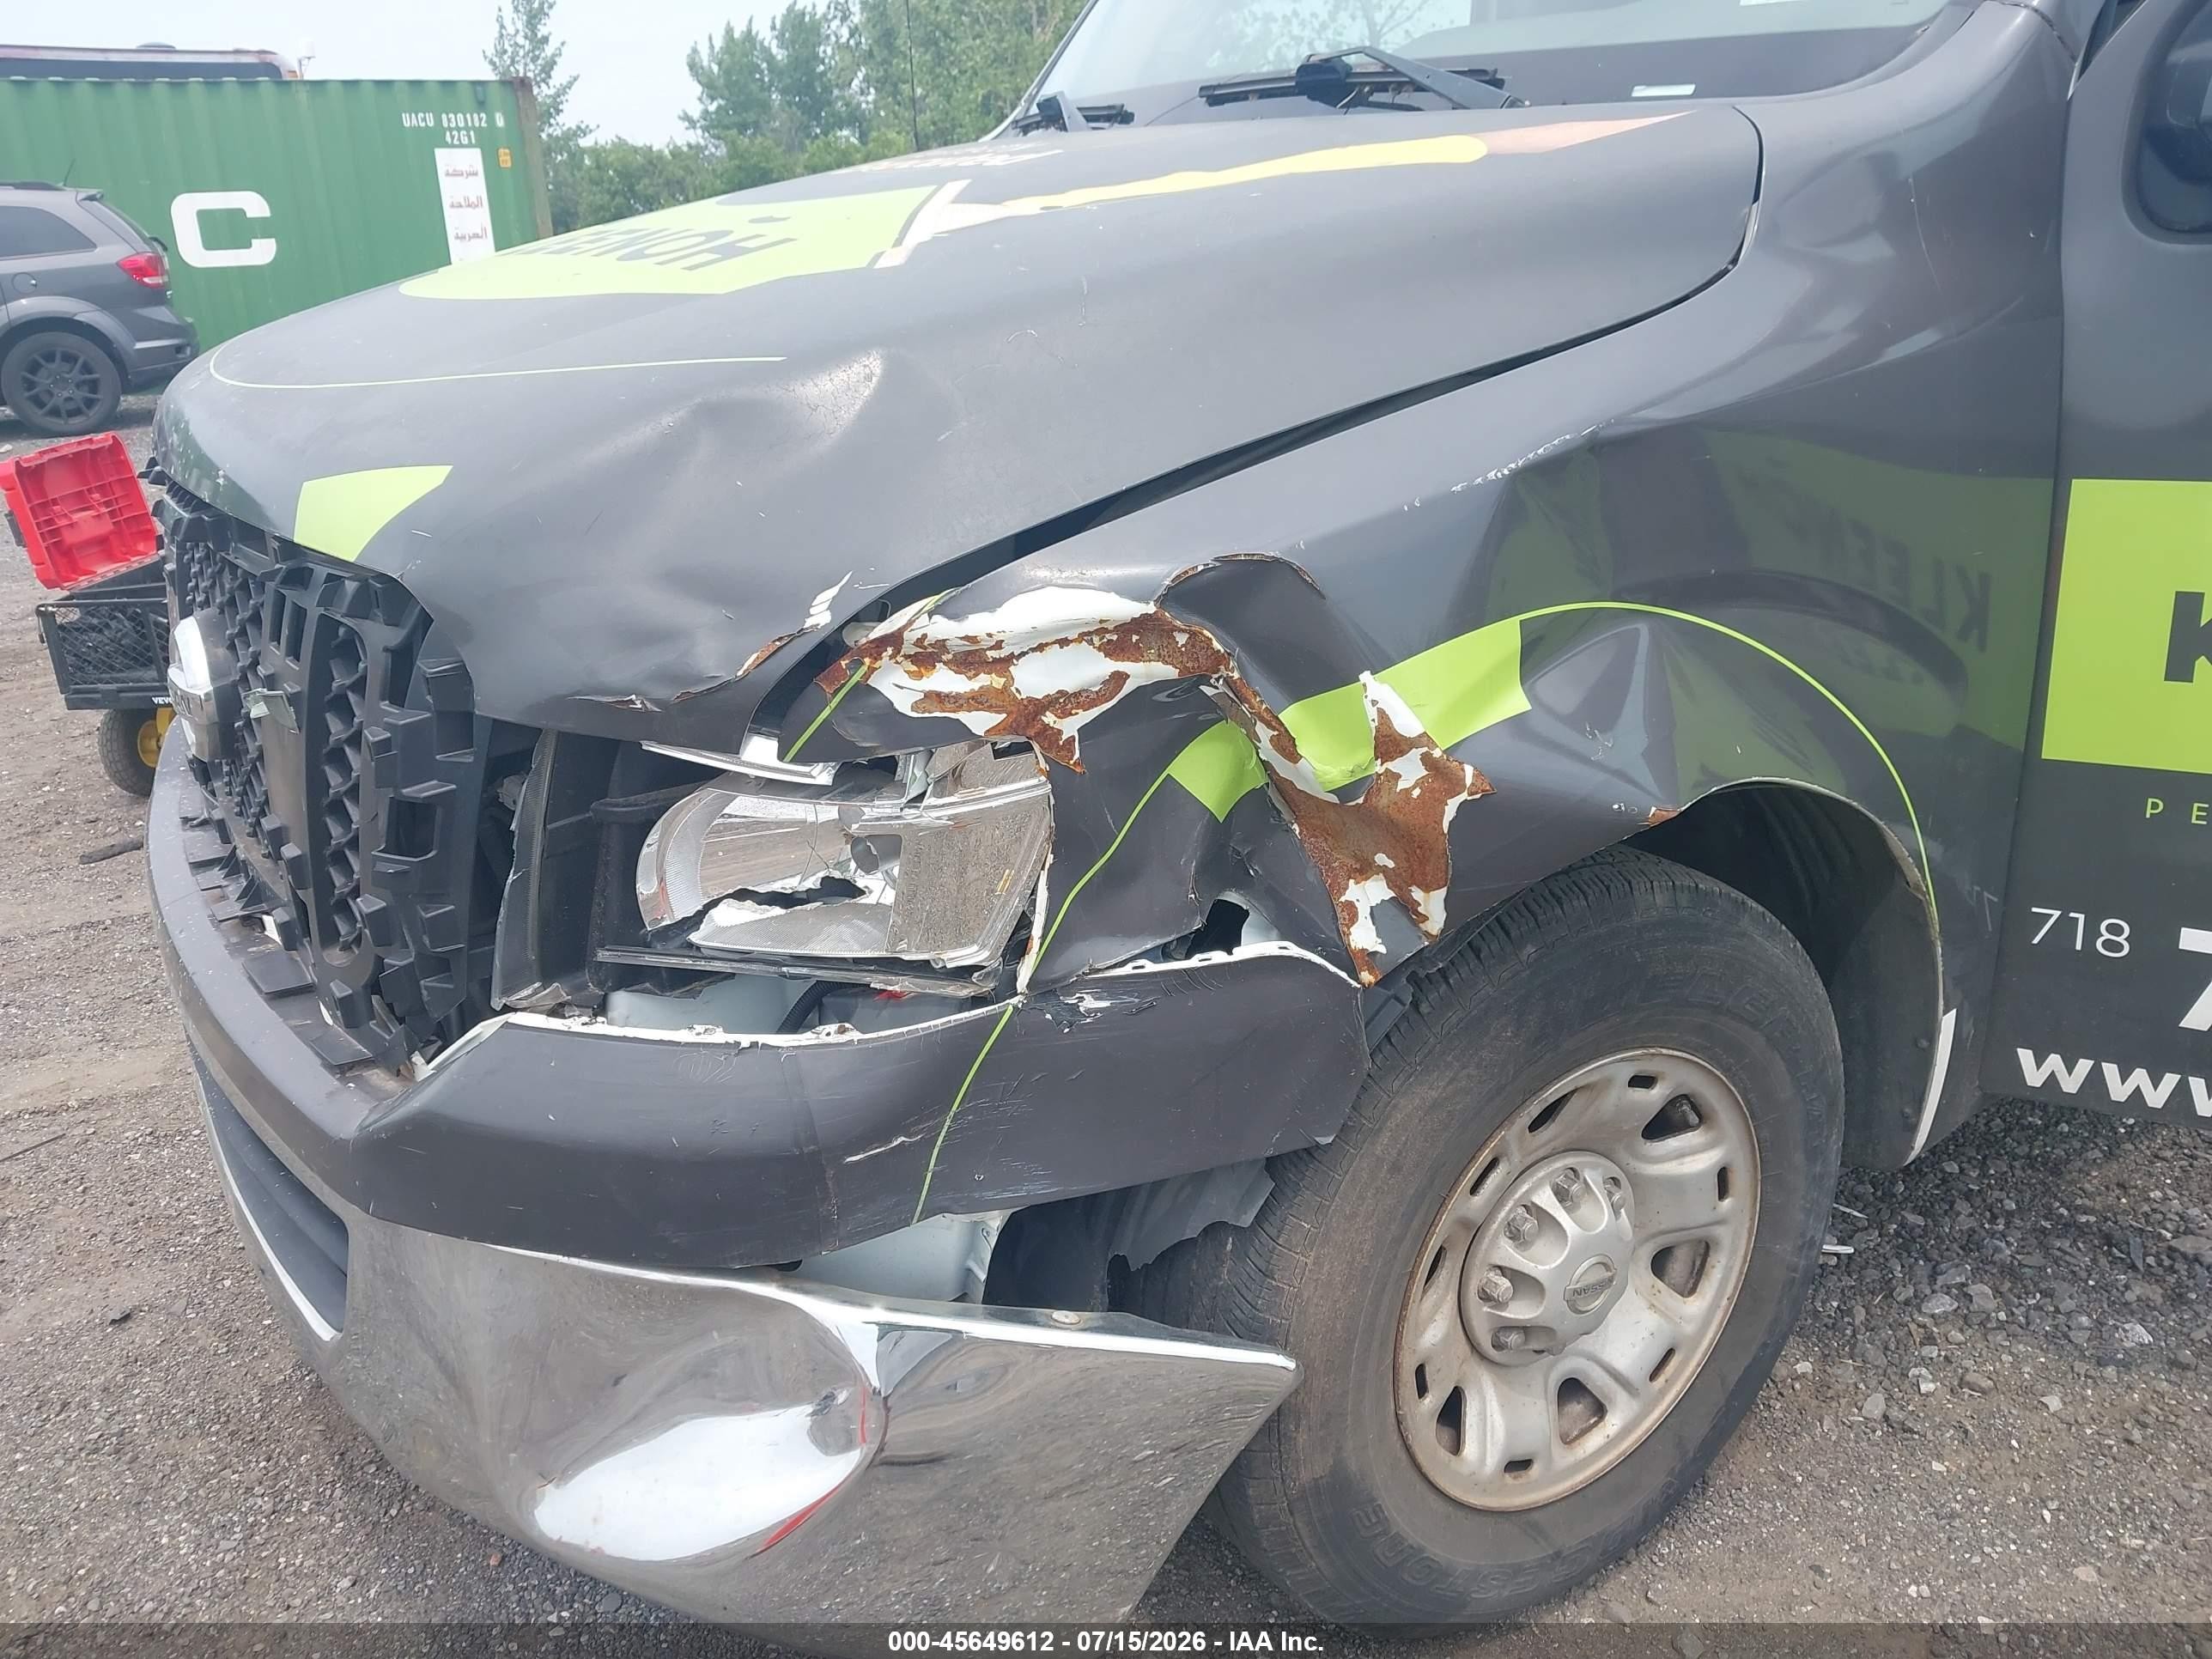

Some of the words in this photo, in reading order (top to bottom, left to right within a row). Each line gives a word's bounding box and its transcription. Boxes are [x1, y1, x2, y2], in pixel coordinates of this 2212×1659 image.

[402, 112, 434, 127] UACU
[445, 130, 476, 144] 42G1
[171, 191, 276, 268] C
[2145, 797, 2209, 825] PE
[2030, 907, 2130, 958] 718
